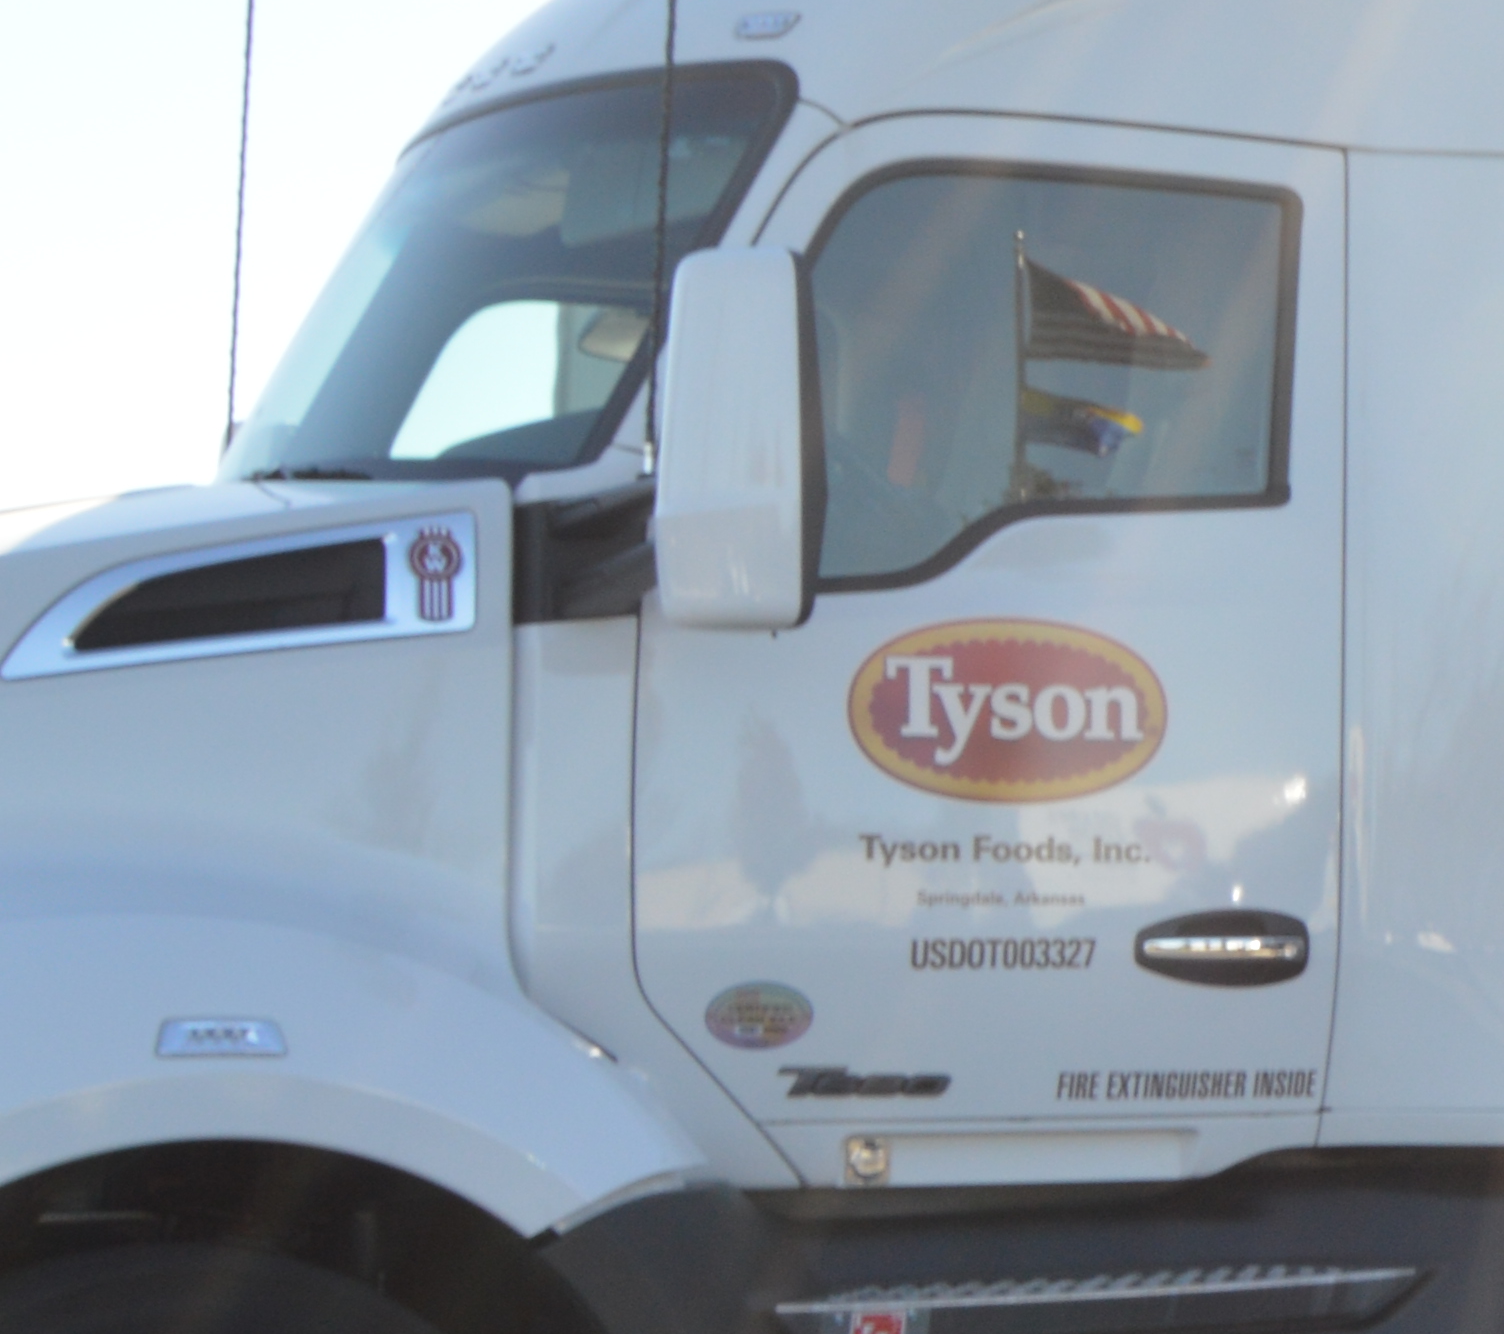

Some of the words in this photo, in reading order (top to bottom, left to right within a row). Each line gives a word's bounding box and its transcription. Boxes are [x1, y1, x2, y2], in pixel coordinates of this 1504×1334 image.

[886, 657, 1143, 765] Tyson
[859, 833, 961, 867] Tyson
[972, 835, 1081, 865] Foods,
[1093, 837, 1151, 863] Inc.
[1013, 890, 1085, 907] Arkansas
[910, 937, 1096, 969] USDOT003327
[1056, 1071, 1098, 1100] FIRE
[1105, 1070, 1247, 1100] EXTINGUISHER
[1253, 1069, 1316, 1099] INSIDE
